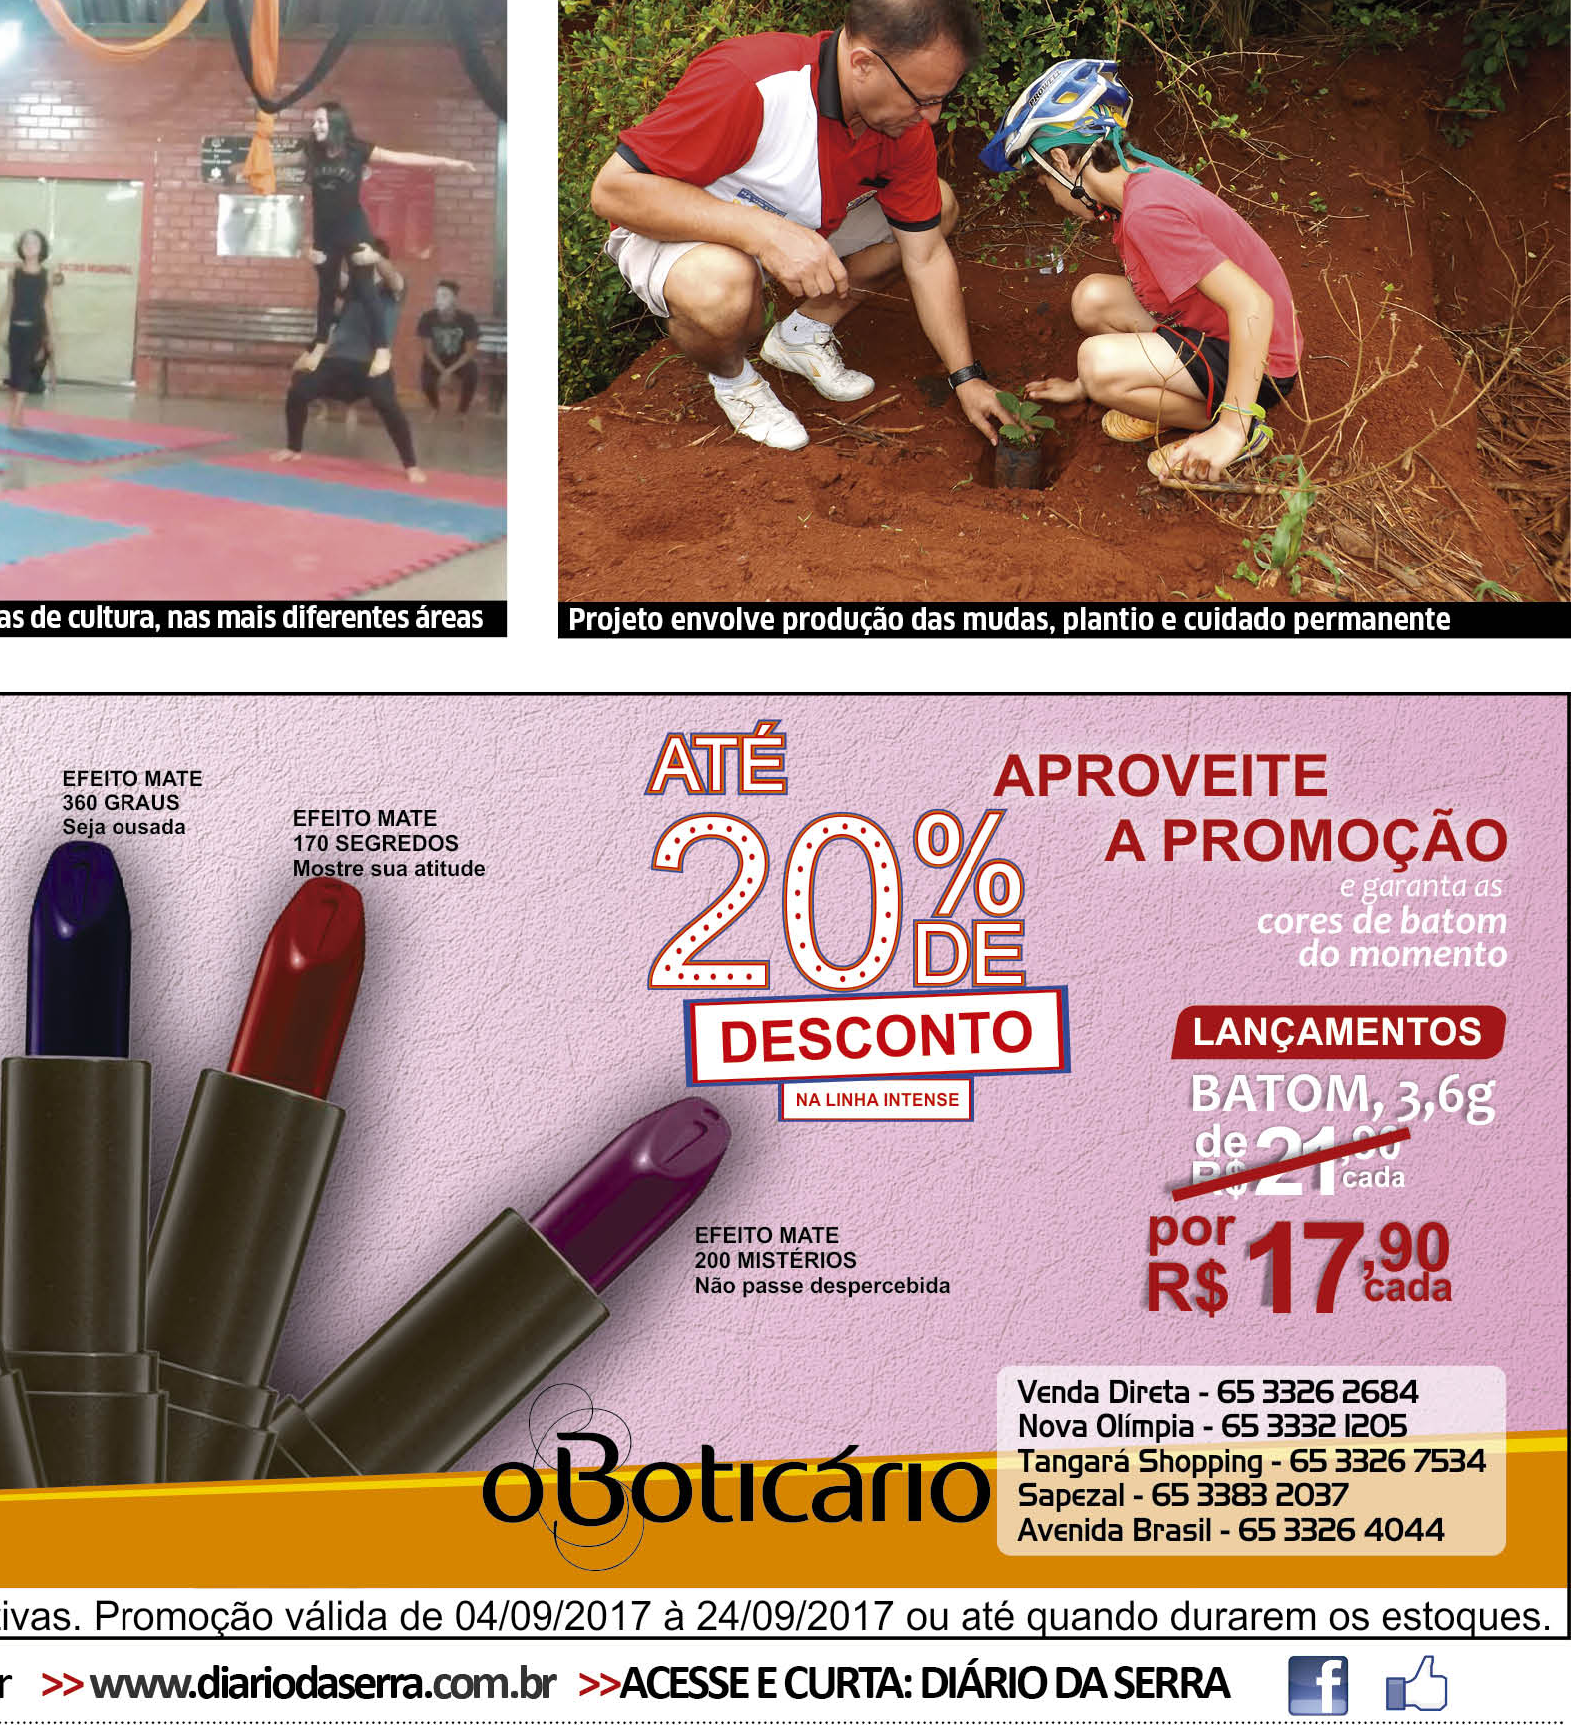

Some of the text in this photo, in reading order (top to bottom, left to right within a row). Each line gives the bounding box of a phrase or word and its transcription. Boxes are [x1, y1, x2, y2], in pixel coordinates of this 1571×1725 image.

[63, 770, 203, 787] EFEITO MATE
[644, 720, 788, 795] ATÉ
[993, 753, 1328, 798] APROVEITE
[63, 794, 180, 811] 360 GRAUS
[62, 818, 186, 839] Seja ousada
[1104, 807, 1508, 874] A PROMOÇÃO
[647, 809, 1026, 993] 20%
[913, 918, 1027, 989] DE
[721, 1009, 1033, 1064] DESCONTO
[1194, 1016, 1482, 1054] LANÇAMENTOS
[796, 1092, 960, 1107] NA LINHA INTENSE
[1191, 1072, 1497, 1126] BATOM, 3,6g
[1148, 1214, 1237, 1257] por
[1147, 1258, 1230, 1319] R$
[1364, 1271, 1453, 1303] cada
[1017, 1517, 1123, 1542] Avenida
[1133, 1517, 1211, 1542] Brasil
[1238, 1517, 1276, 1542] 65
[1284, 1517, 1356, 1542] 3326
[1364, 1517, 1445, 1542] 4044
[89, 1664, 558, 1700] www.diariodaserra.com.br
